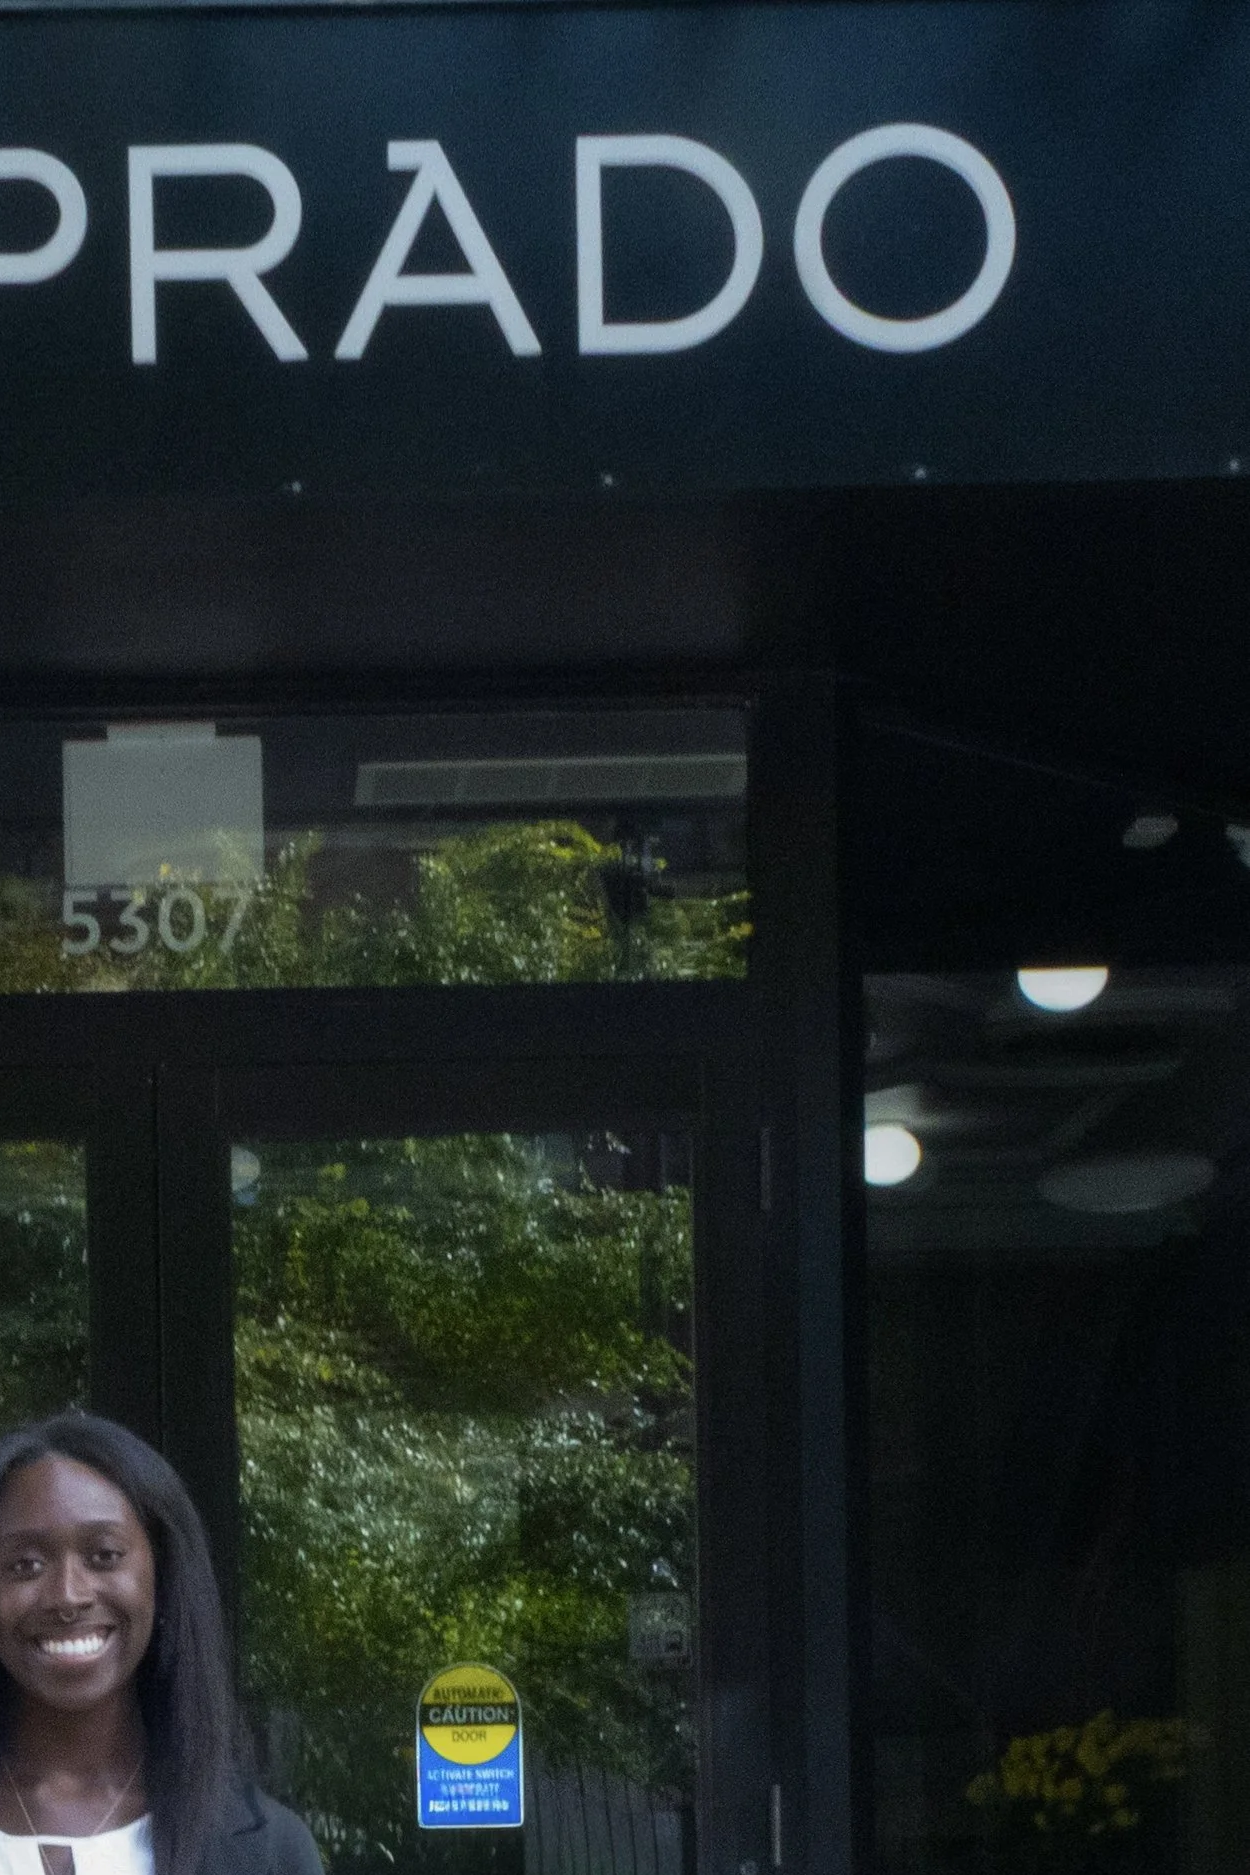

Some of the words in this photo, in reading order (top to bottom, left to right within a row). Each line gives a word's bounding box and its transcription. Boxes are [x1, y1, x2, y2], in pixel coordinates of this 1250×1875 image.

[62, 888, 253, 953] 5307
[429, 1706, 509, 1724] CAUTION
[452, 1730, 487, 1743] DOOR
